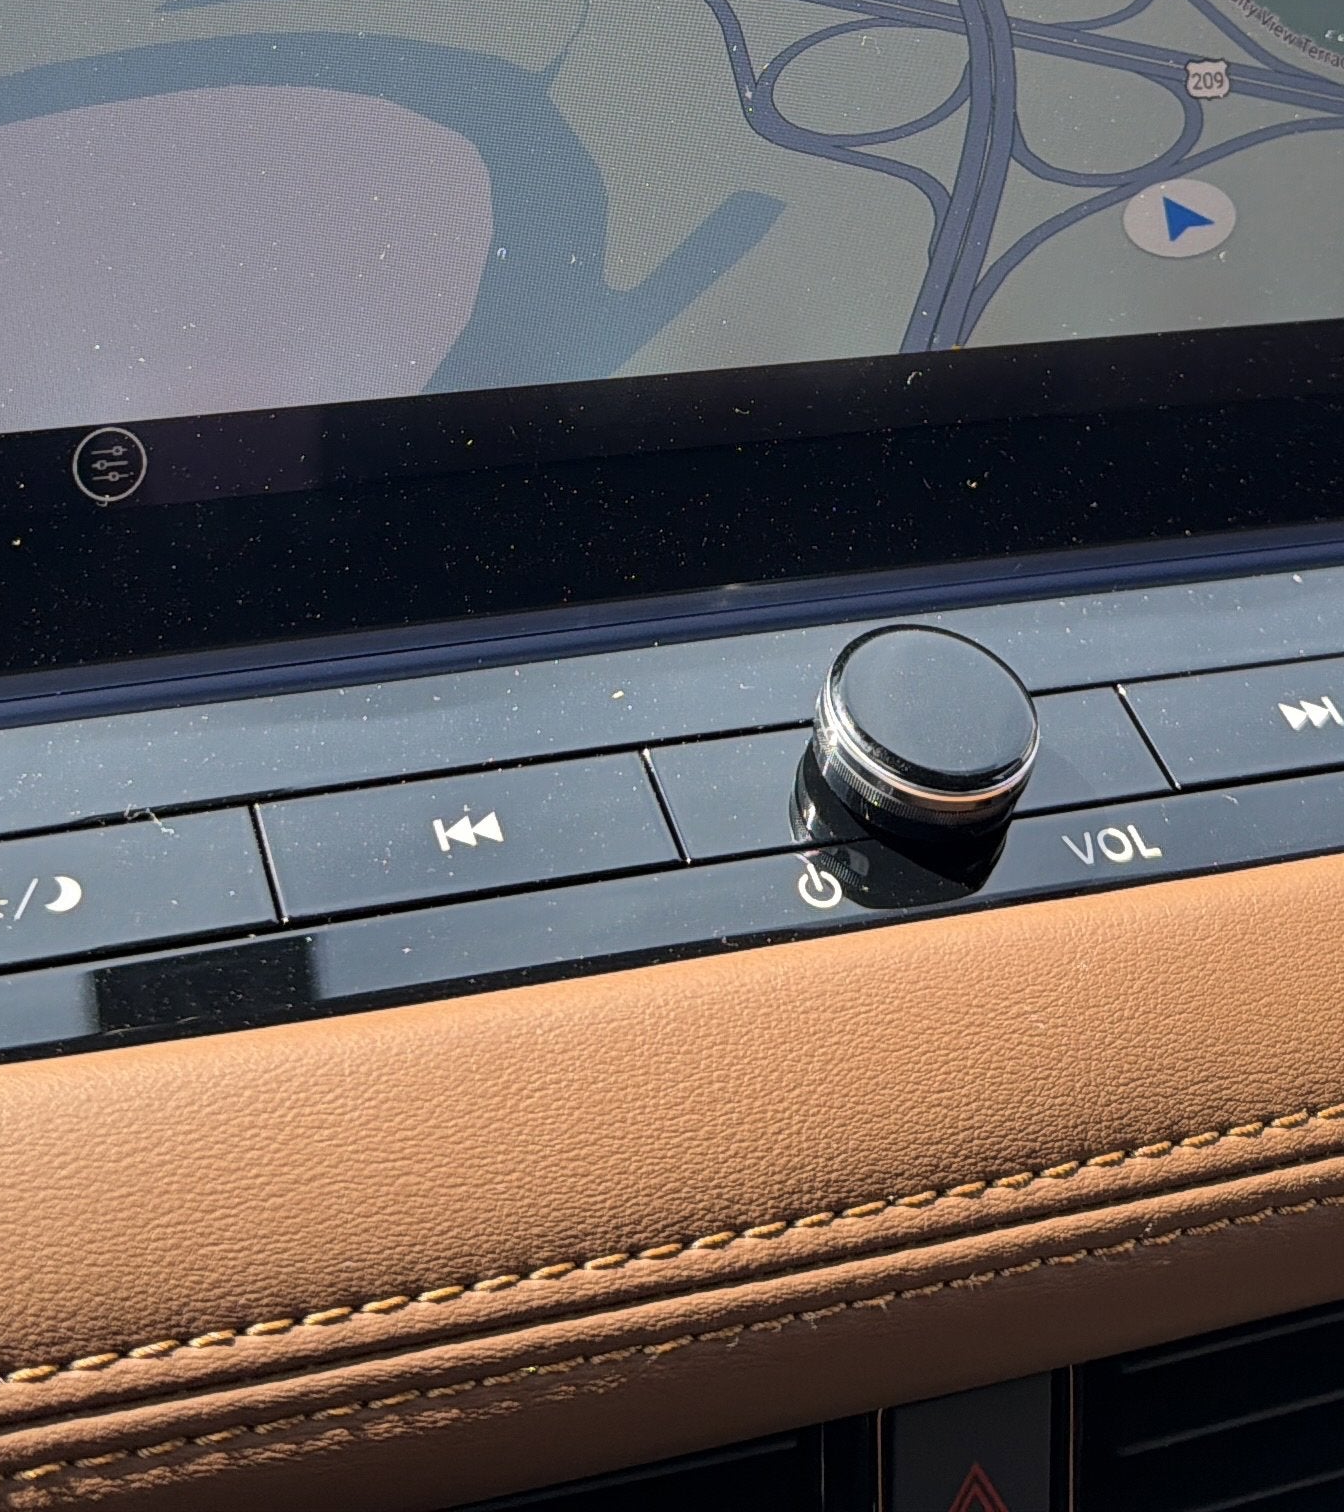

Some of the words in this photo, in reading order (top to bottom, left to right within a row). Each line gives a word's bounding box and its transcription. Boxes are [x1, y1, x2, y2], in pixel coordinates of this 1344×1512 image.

[1261, 9, 1299, 44] View
[1191, 71, 1225, 90] 209
[1062, 823, 1162, 866] VOL
